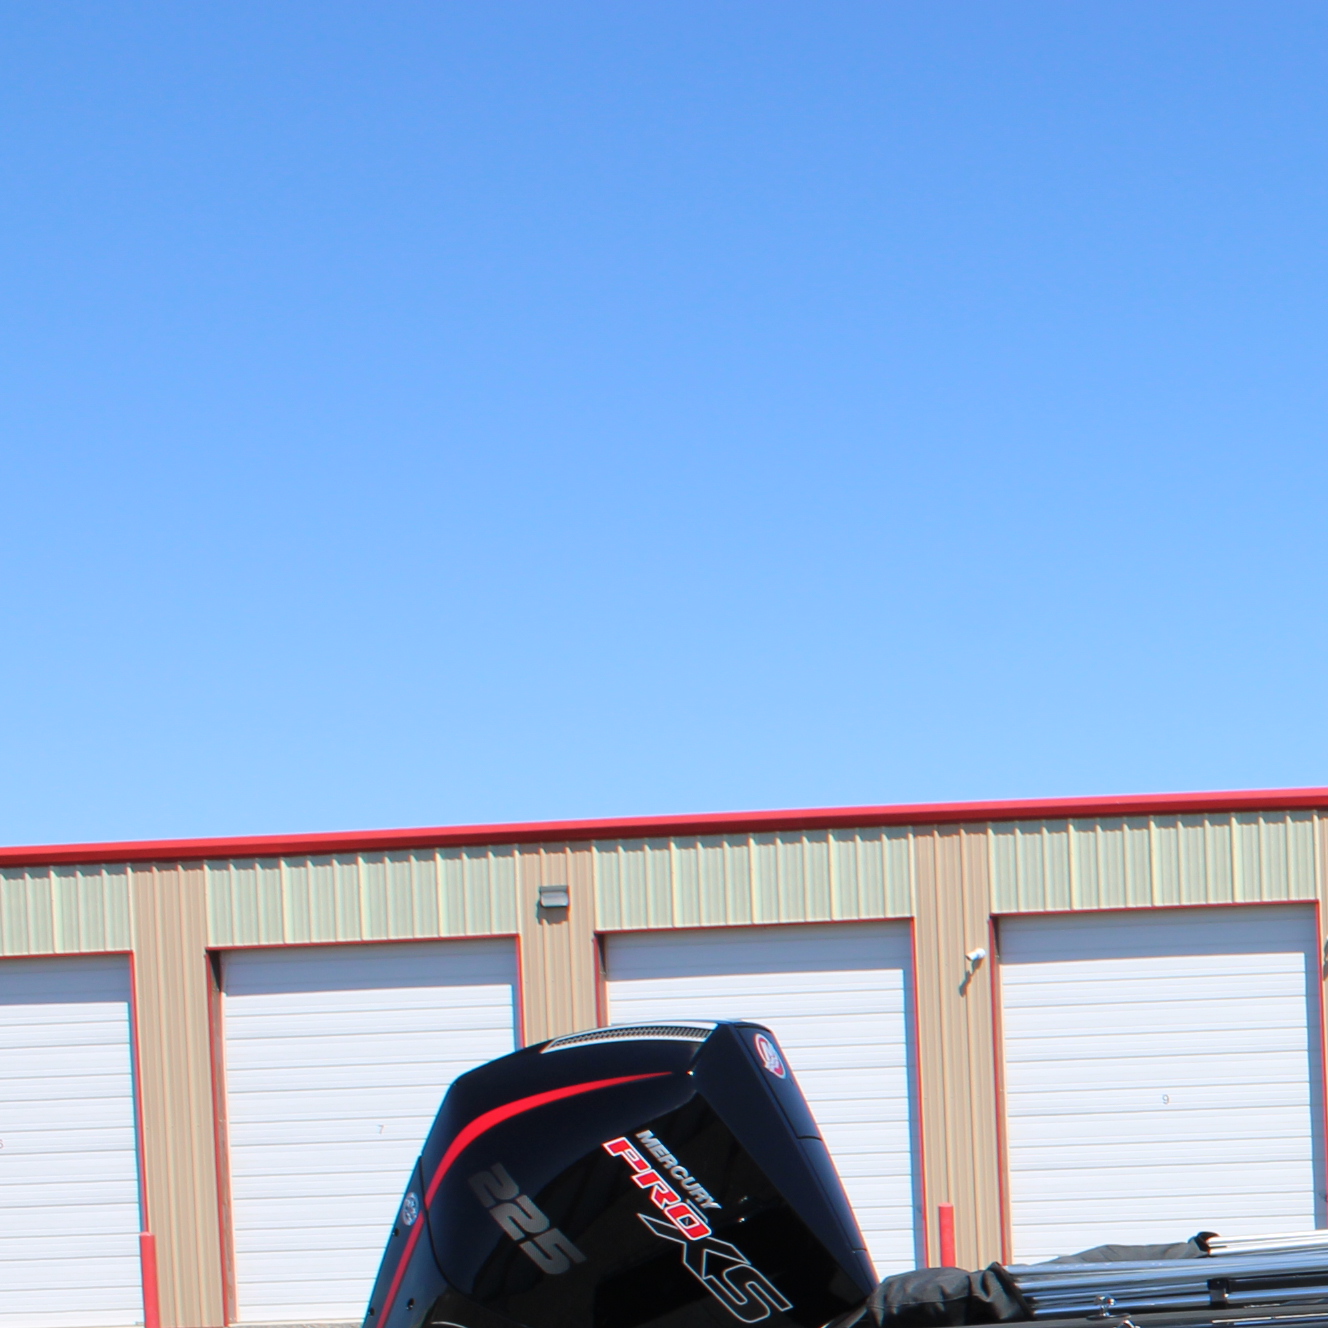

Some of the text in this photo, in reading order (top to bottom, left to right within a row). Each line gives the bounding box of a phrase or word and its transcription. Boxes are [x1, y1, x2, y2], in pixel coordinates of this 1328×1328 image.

[377, 1124, 385, 1135] 7
[1161, 1094, 1170, 1105] 9
[636, 1130, 722, 1209] MERCURY
[467, 1162, 587, 1275] 225
[602, 1137, 793, 1323] PRO XS
